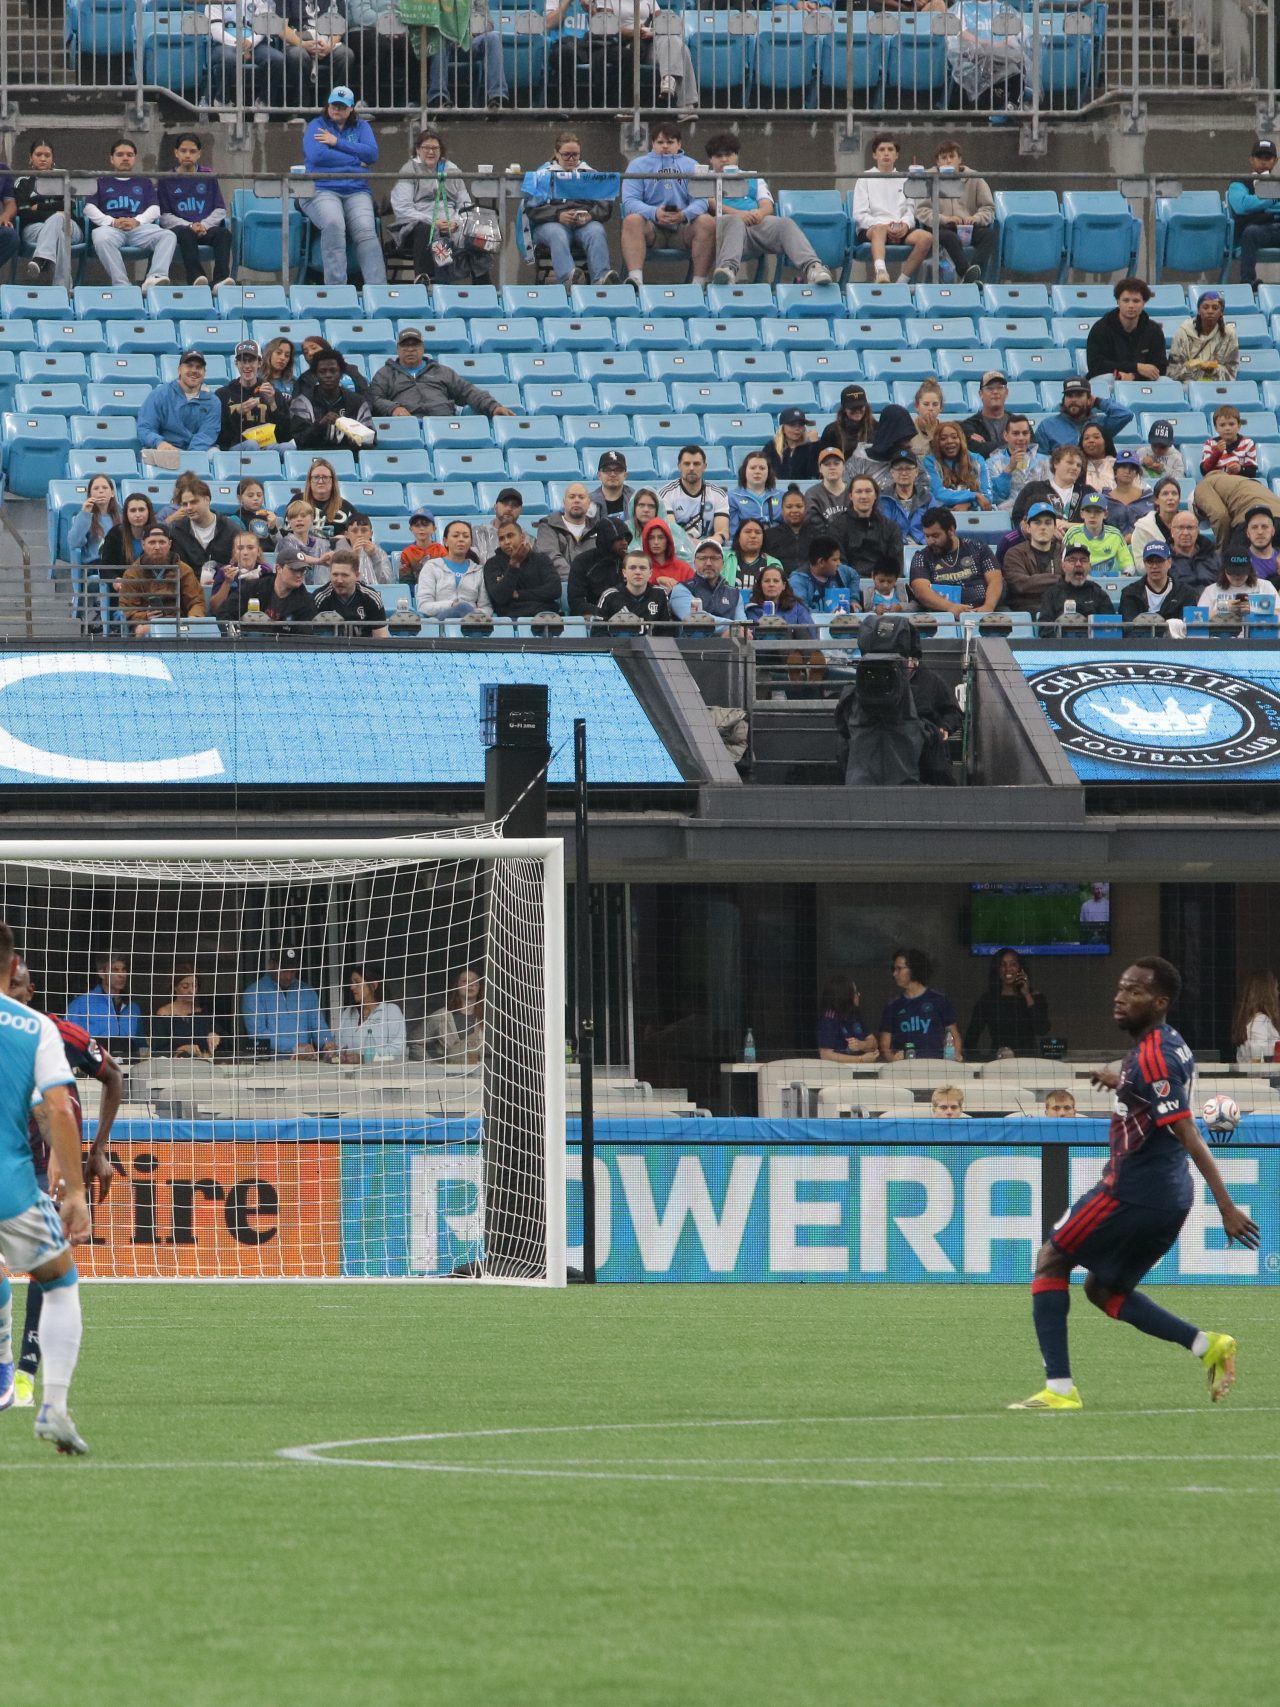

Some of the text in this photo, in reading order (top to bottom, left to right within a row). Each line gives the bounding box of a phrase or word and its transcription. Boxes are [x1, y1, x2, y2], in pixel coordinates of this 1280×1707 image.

[106, 195, 141, 213] ally
[177, 196, 206, 214] ally
[1154, 428, 1169, 438] USA
[1036, 667, 1250, 696] CHARLOTTE
[1069, 735, 1277, 763] FOOTBALL CLUB
[900, 1015, 931, 1034] ally
